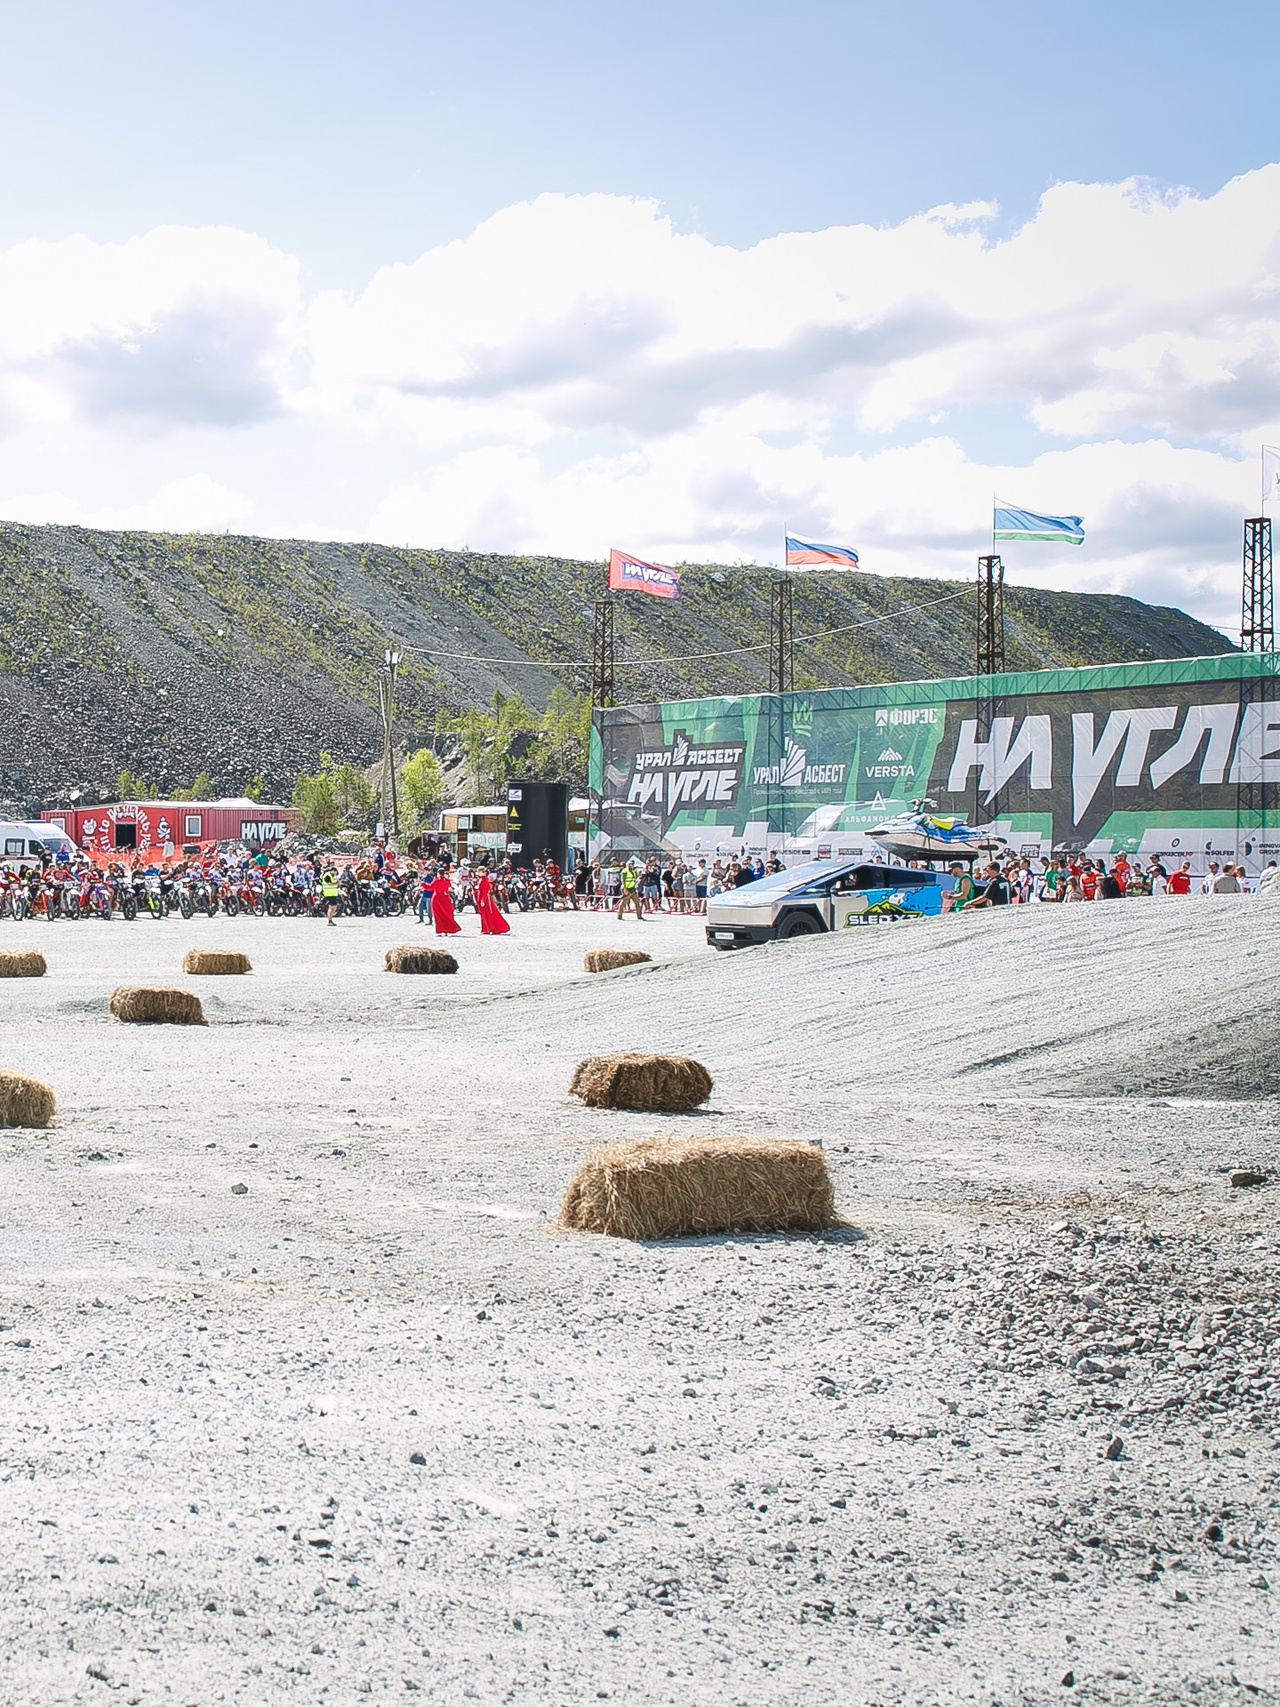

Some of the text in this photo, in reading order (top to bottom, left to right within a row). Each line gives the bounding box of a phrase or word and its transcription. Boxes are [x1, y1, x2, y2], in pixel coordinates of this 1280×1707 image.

[890, 708, 937, 725] ФОРЭС
[636, 748, 743, 770] УРАЛ АСБЕСТ
[754, 764, 845, 784] УРАЛ АСБЕСТ
[866, 765, 915, 777] VERSTA
[258, 822, 287, 847] УГЛЕ
